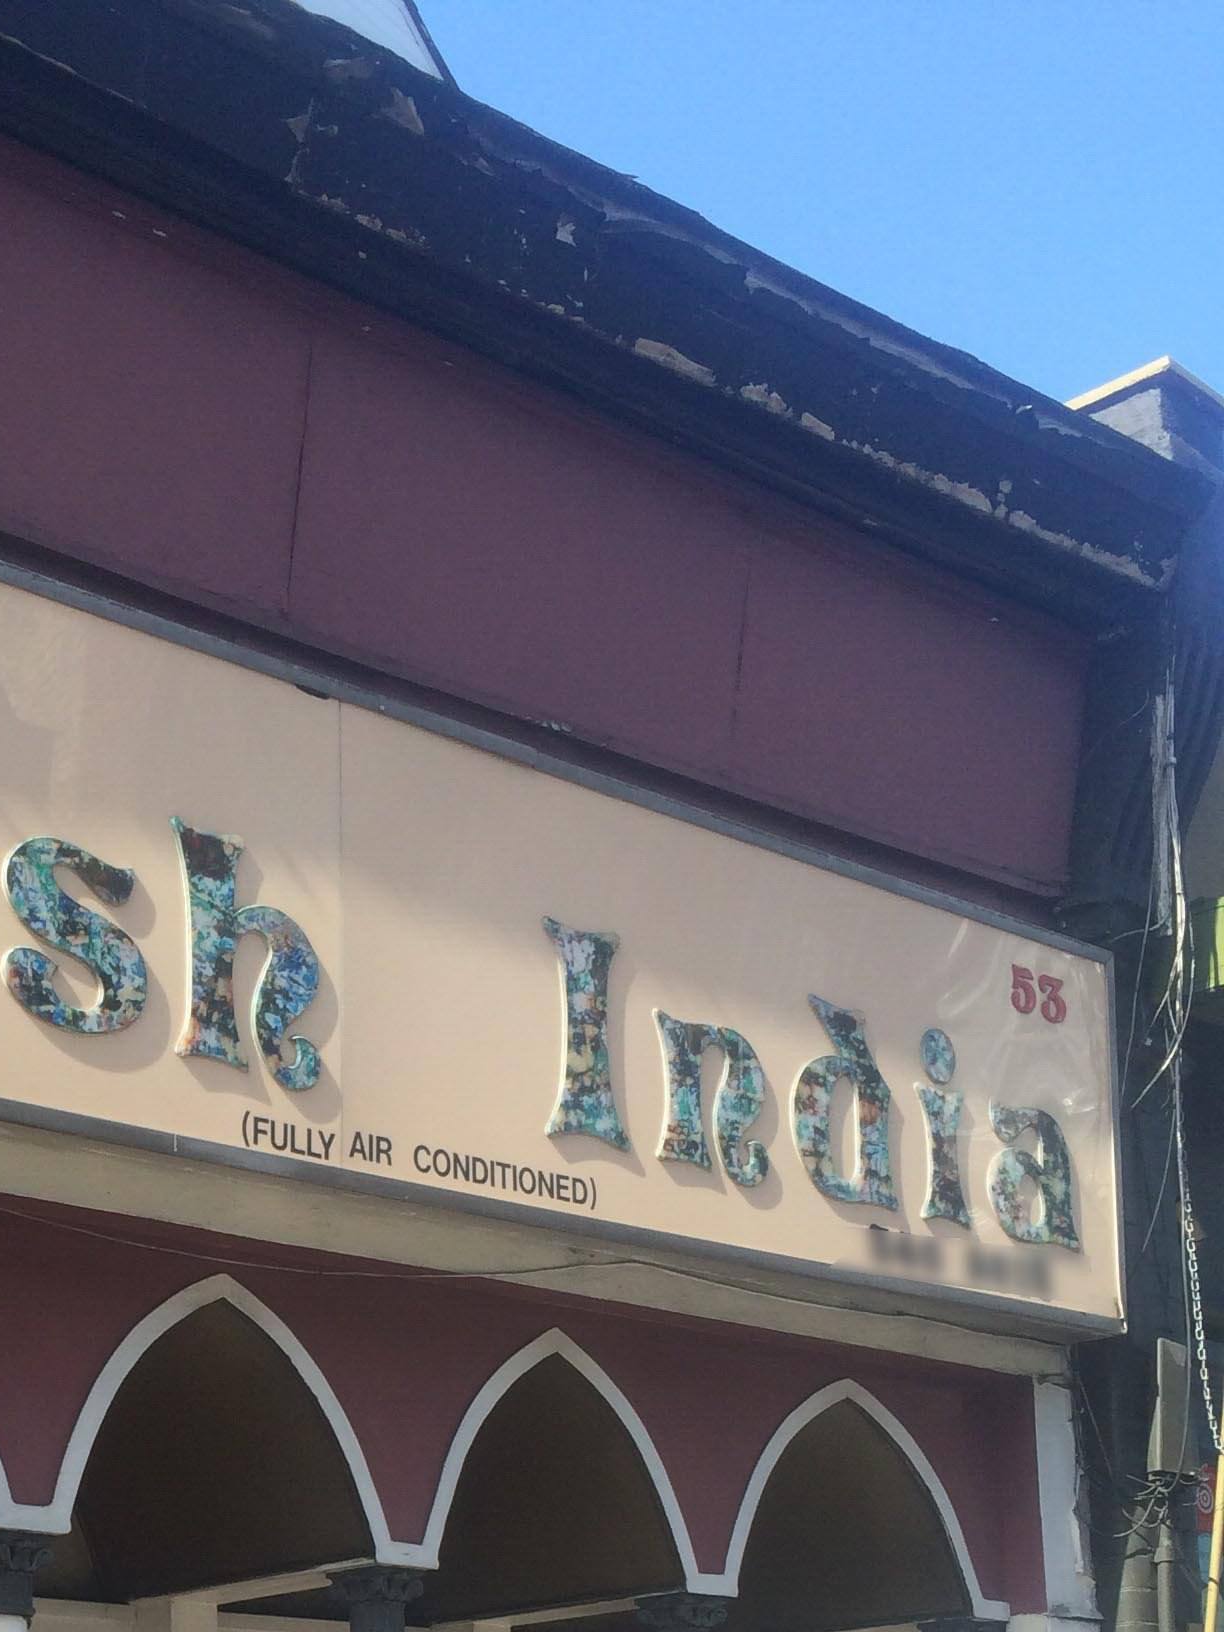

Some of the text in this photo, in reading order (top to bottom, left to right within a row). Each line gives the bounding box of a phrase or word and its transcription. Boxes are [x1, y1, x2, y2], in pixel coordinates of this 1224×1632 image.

[1011, 965, 1067, 1024] 53
[542, 915, 1082, 1254] India
[243, 1111, 598, 1209] (FULLY AIR CONDITIONED)
